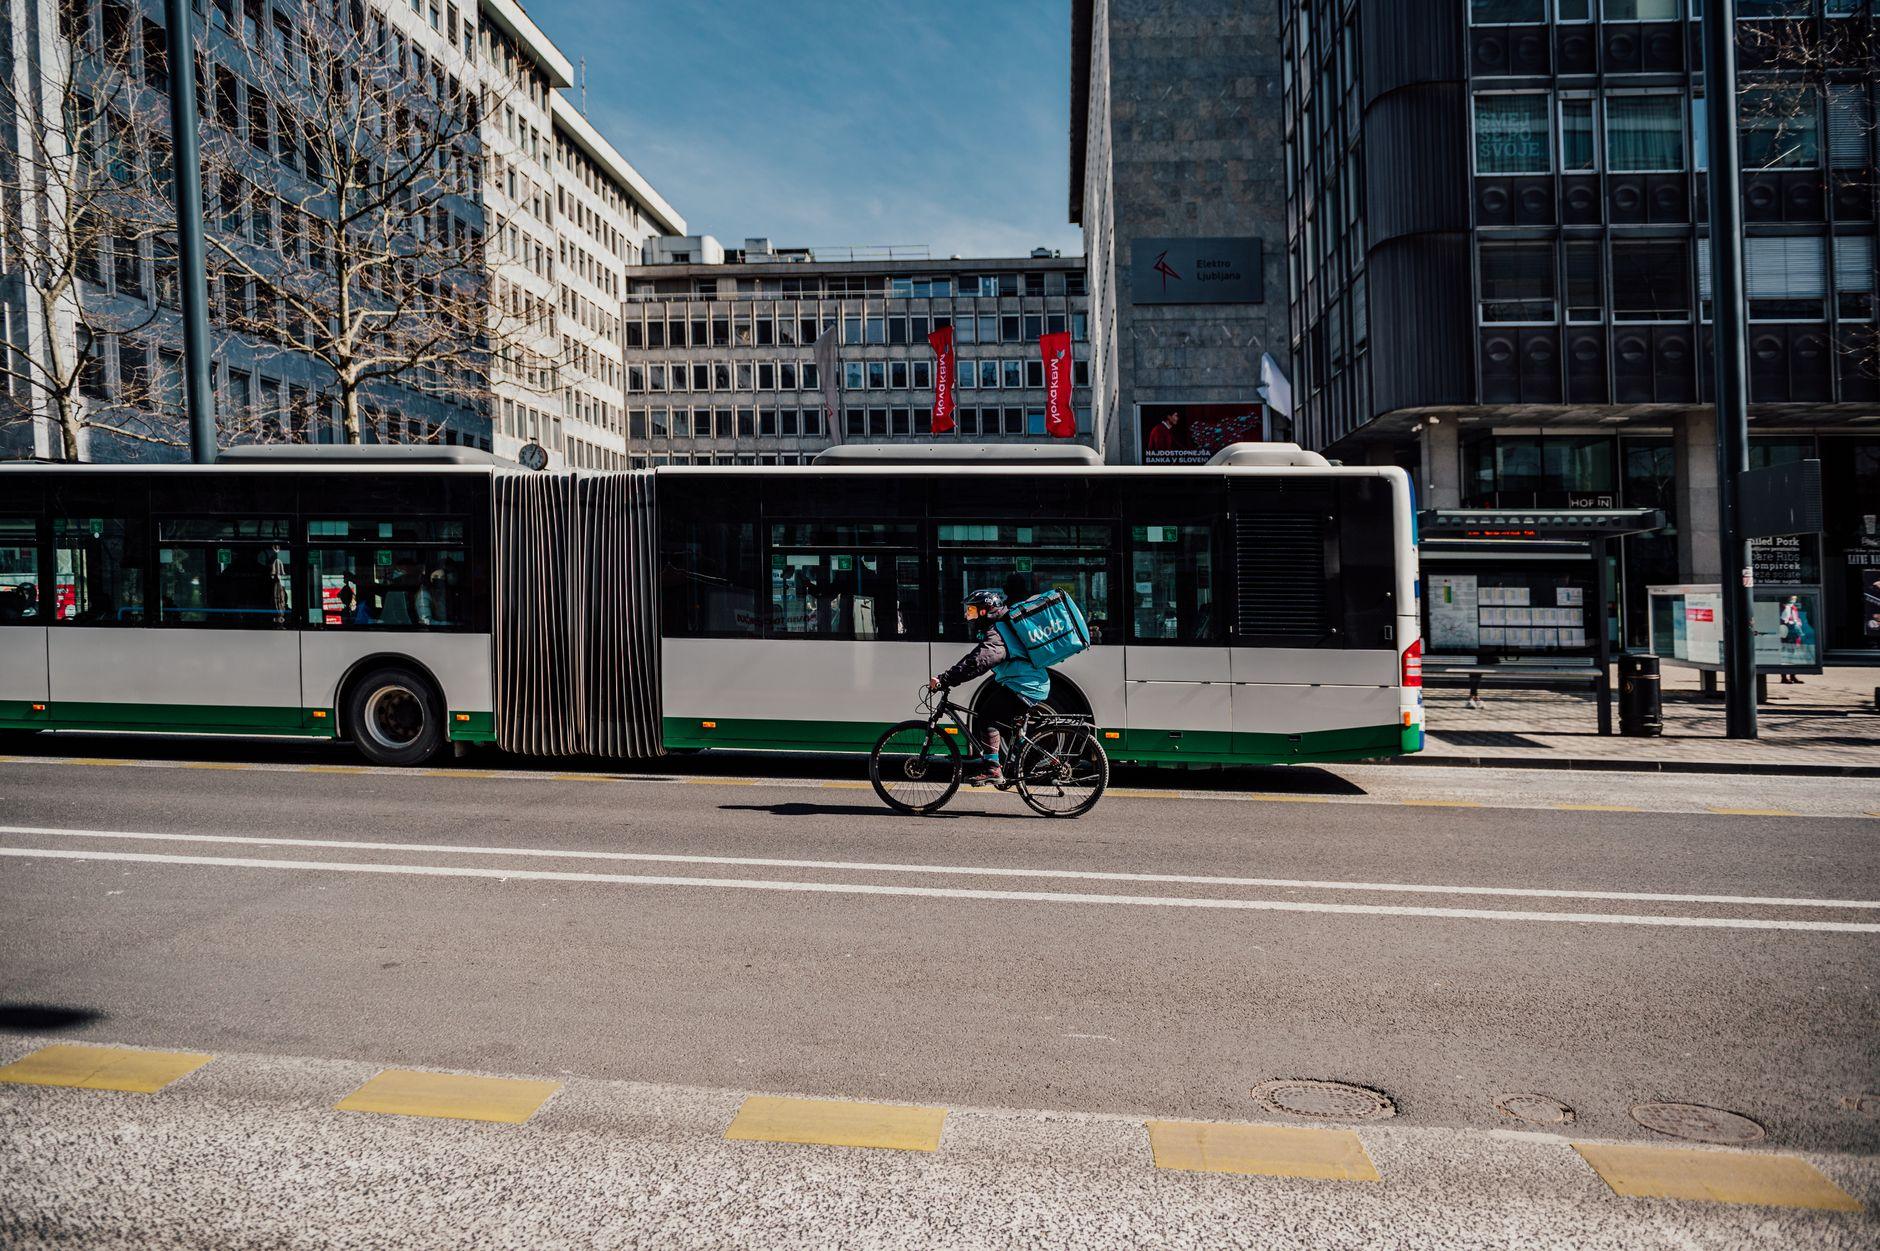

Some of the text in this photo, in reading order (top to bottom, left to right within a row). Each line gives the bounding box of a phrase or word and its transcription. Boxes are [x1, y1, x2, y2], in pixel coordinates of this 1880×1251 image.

[1479, 112, 1530, 127] SMEJ
[1479, 127, 1532, 142] SE PO
[1196, 259, 1231, 268] Elektro
[1196, 271, 1241, 282] Ljubljana
[1597, 499, 1609, 507] IN
[1775, 536, 1800, 546] Pork
[1775, 551, 1800, 561] Ribs
[1752, 561, 1801, 571] ompirček
[1028, 617, 1065, 635] Wolt
